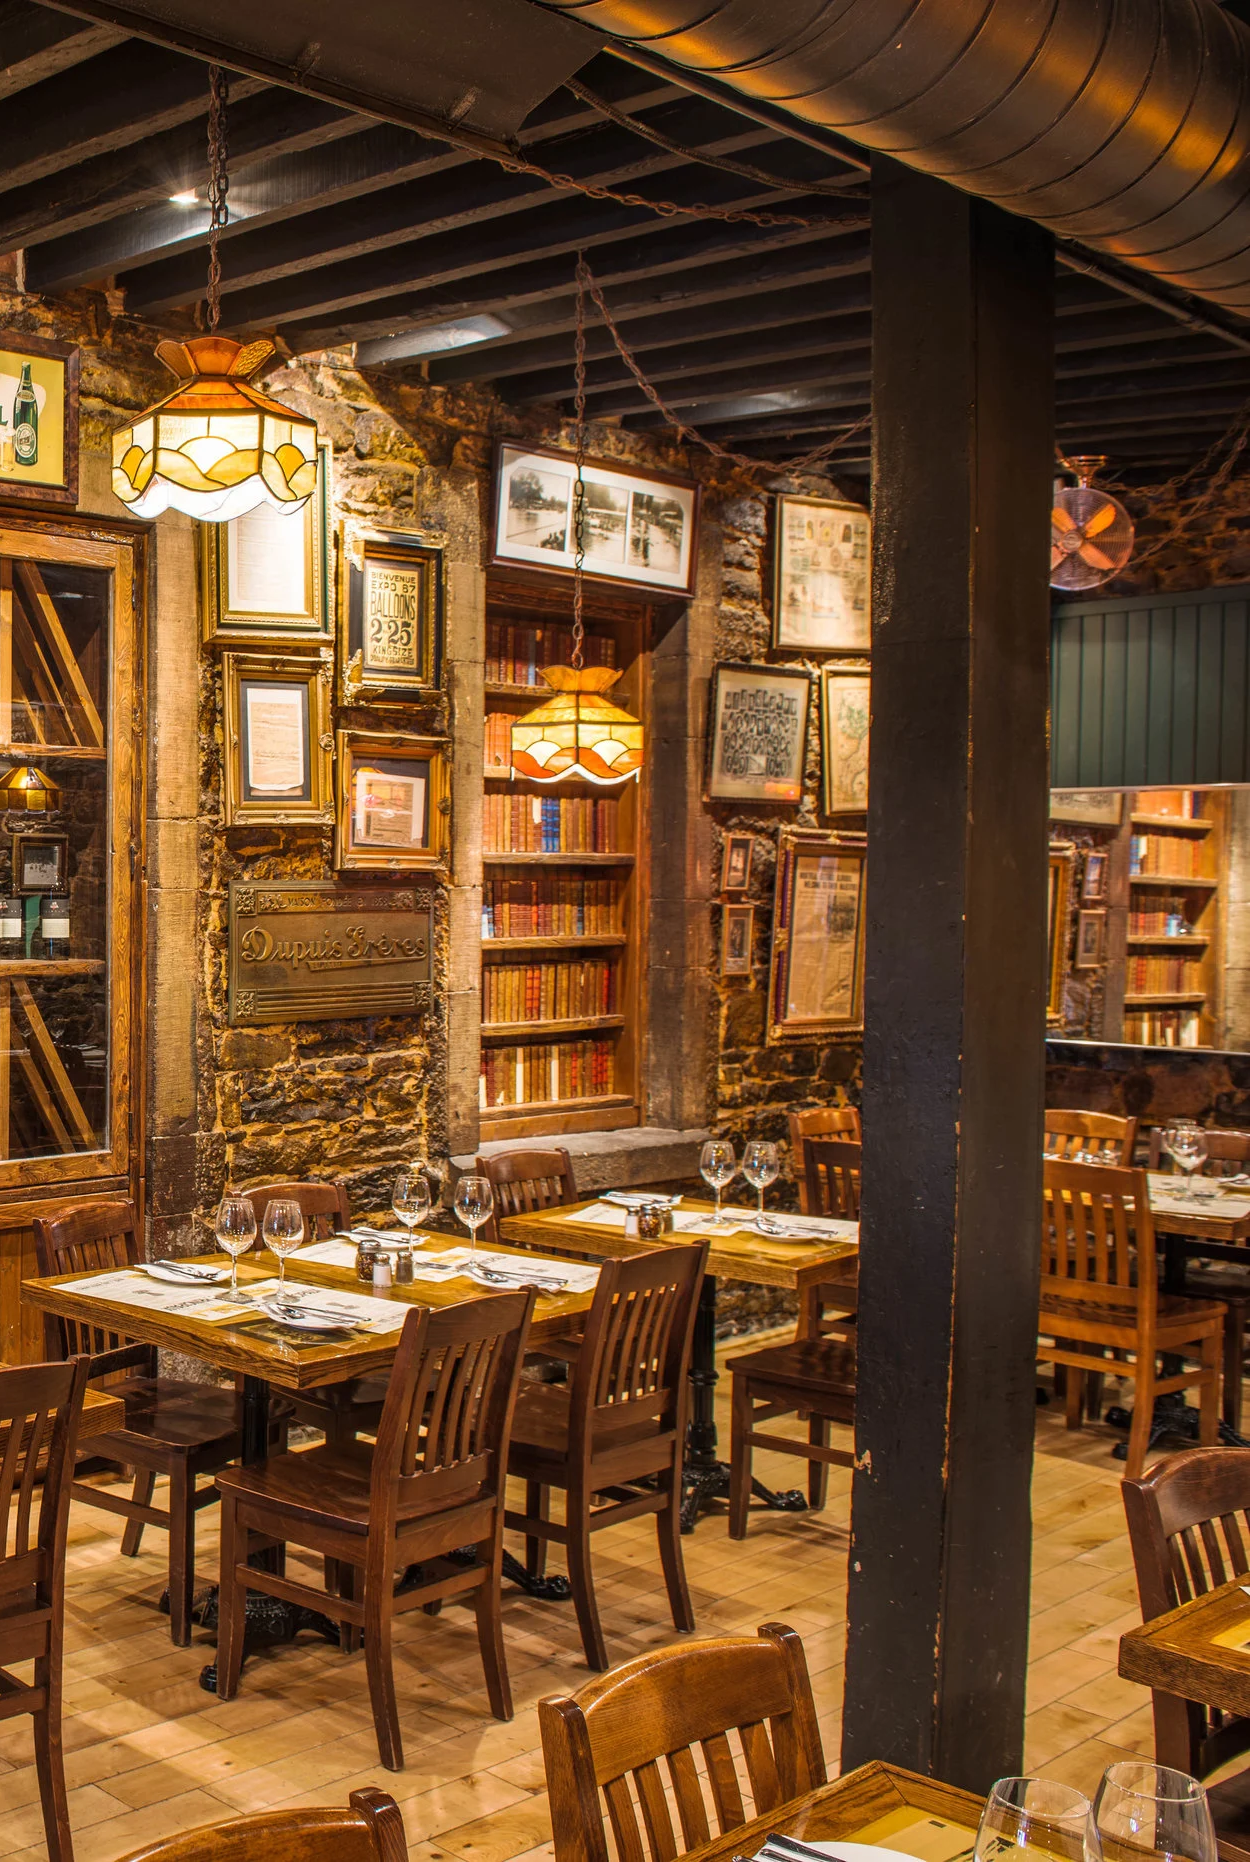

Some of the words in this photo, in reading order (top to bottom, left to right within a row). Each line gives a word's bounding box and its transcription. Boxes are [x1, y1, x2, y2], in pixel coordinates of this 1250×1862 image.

[370, 571, 417, 585] BIENVENUE
[370, 579, 398, 592] EXPO
[370, 590, 417, 621] BALLOONS
[370, 617, 383, 644] 2
[287, 897, 316, 908] MAISON
[241, 925, 343, 970] Dupuis
[344, 925, 428, 960] Frères
